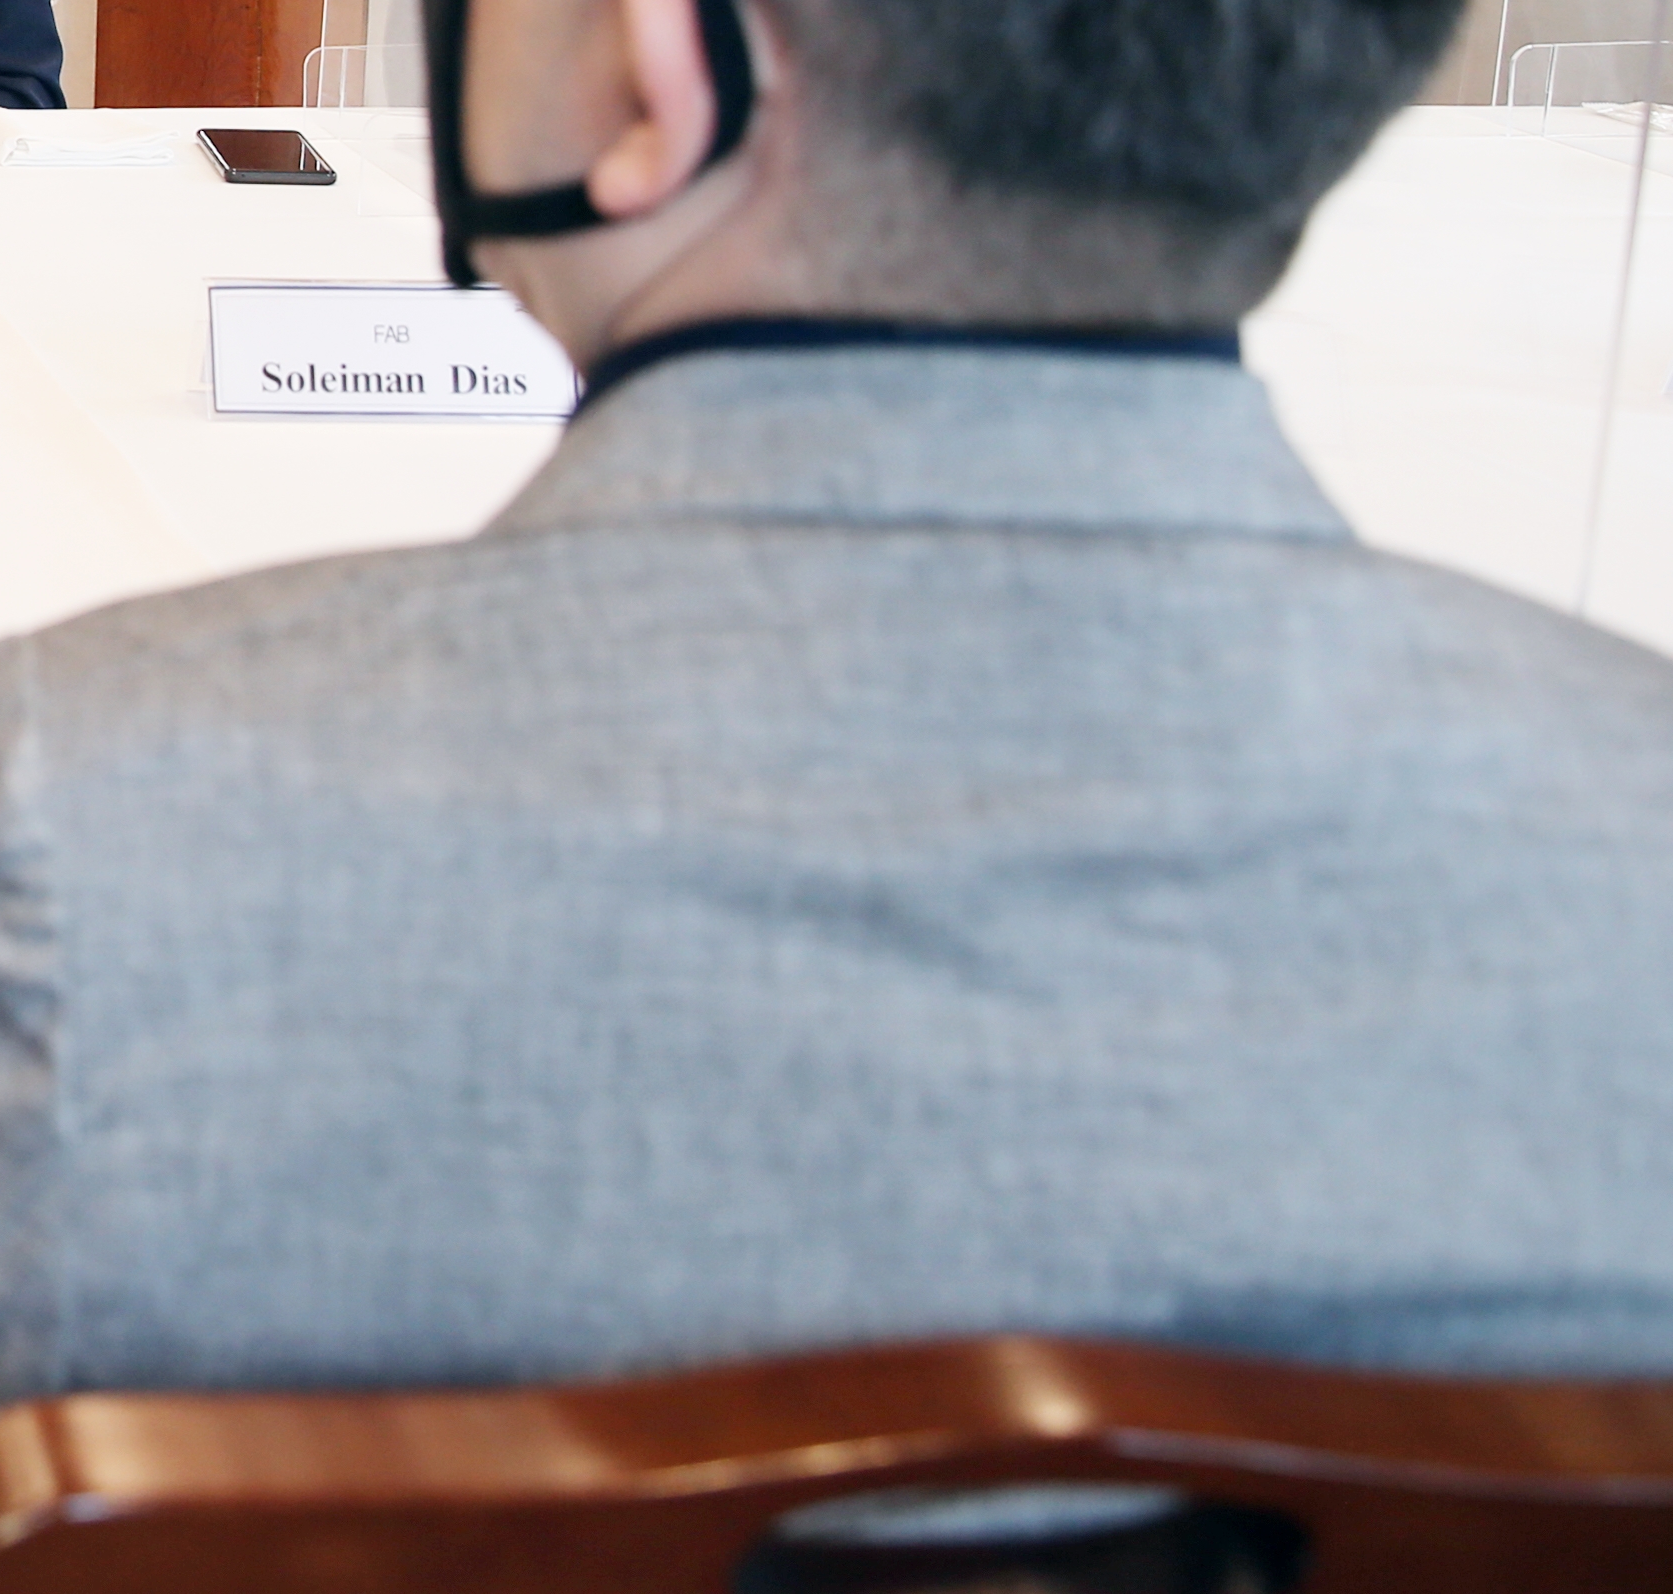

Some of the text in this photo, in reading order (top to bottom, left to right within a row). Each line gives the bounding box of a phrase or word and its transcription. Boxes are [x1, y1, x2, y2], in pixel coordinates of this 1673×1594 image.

[374, 324, 410, 344] FAB
[261, 361, 528, 395] Soleiman Dias
